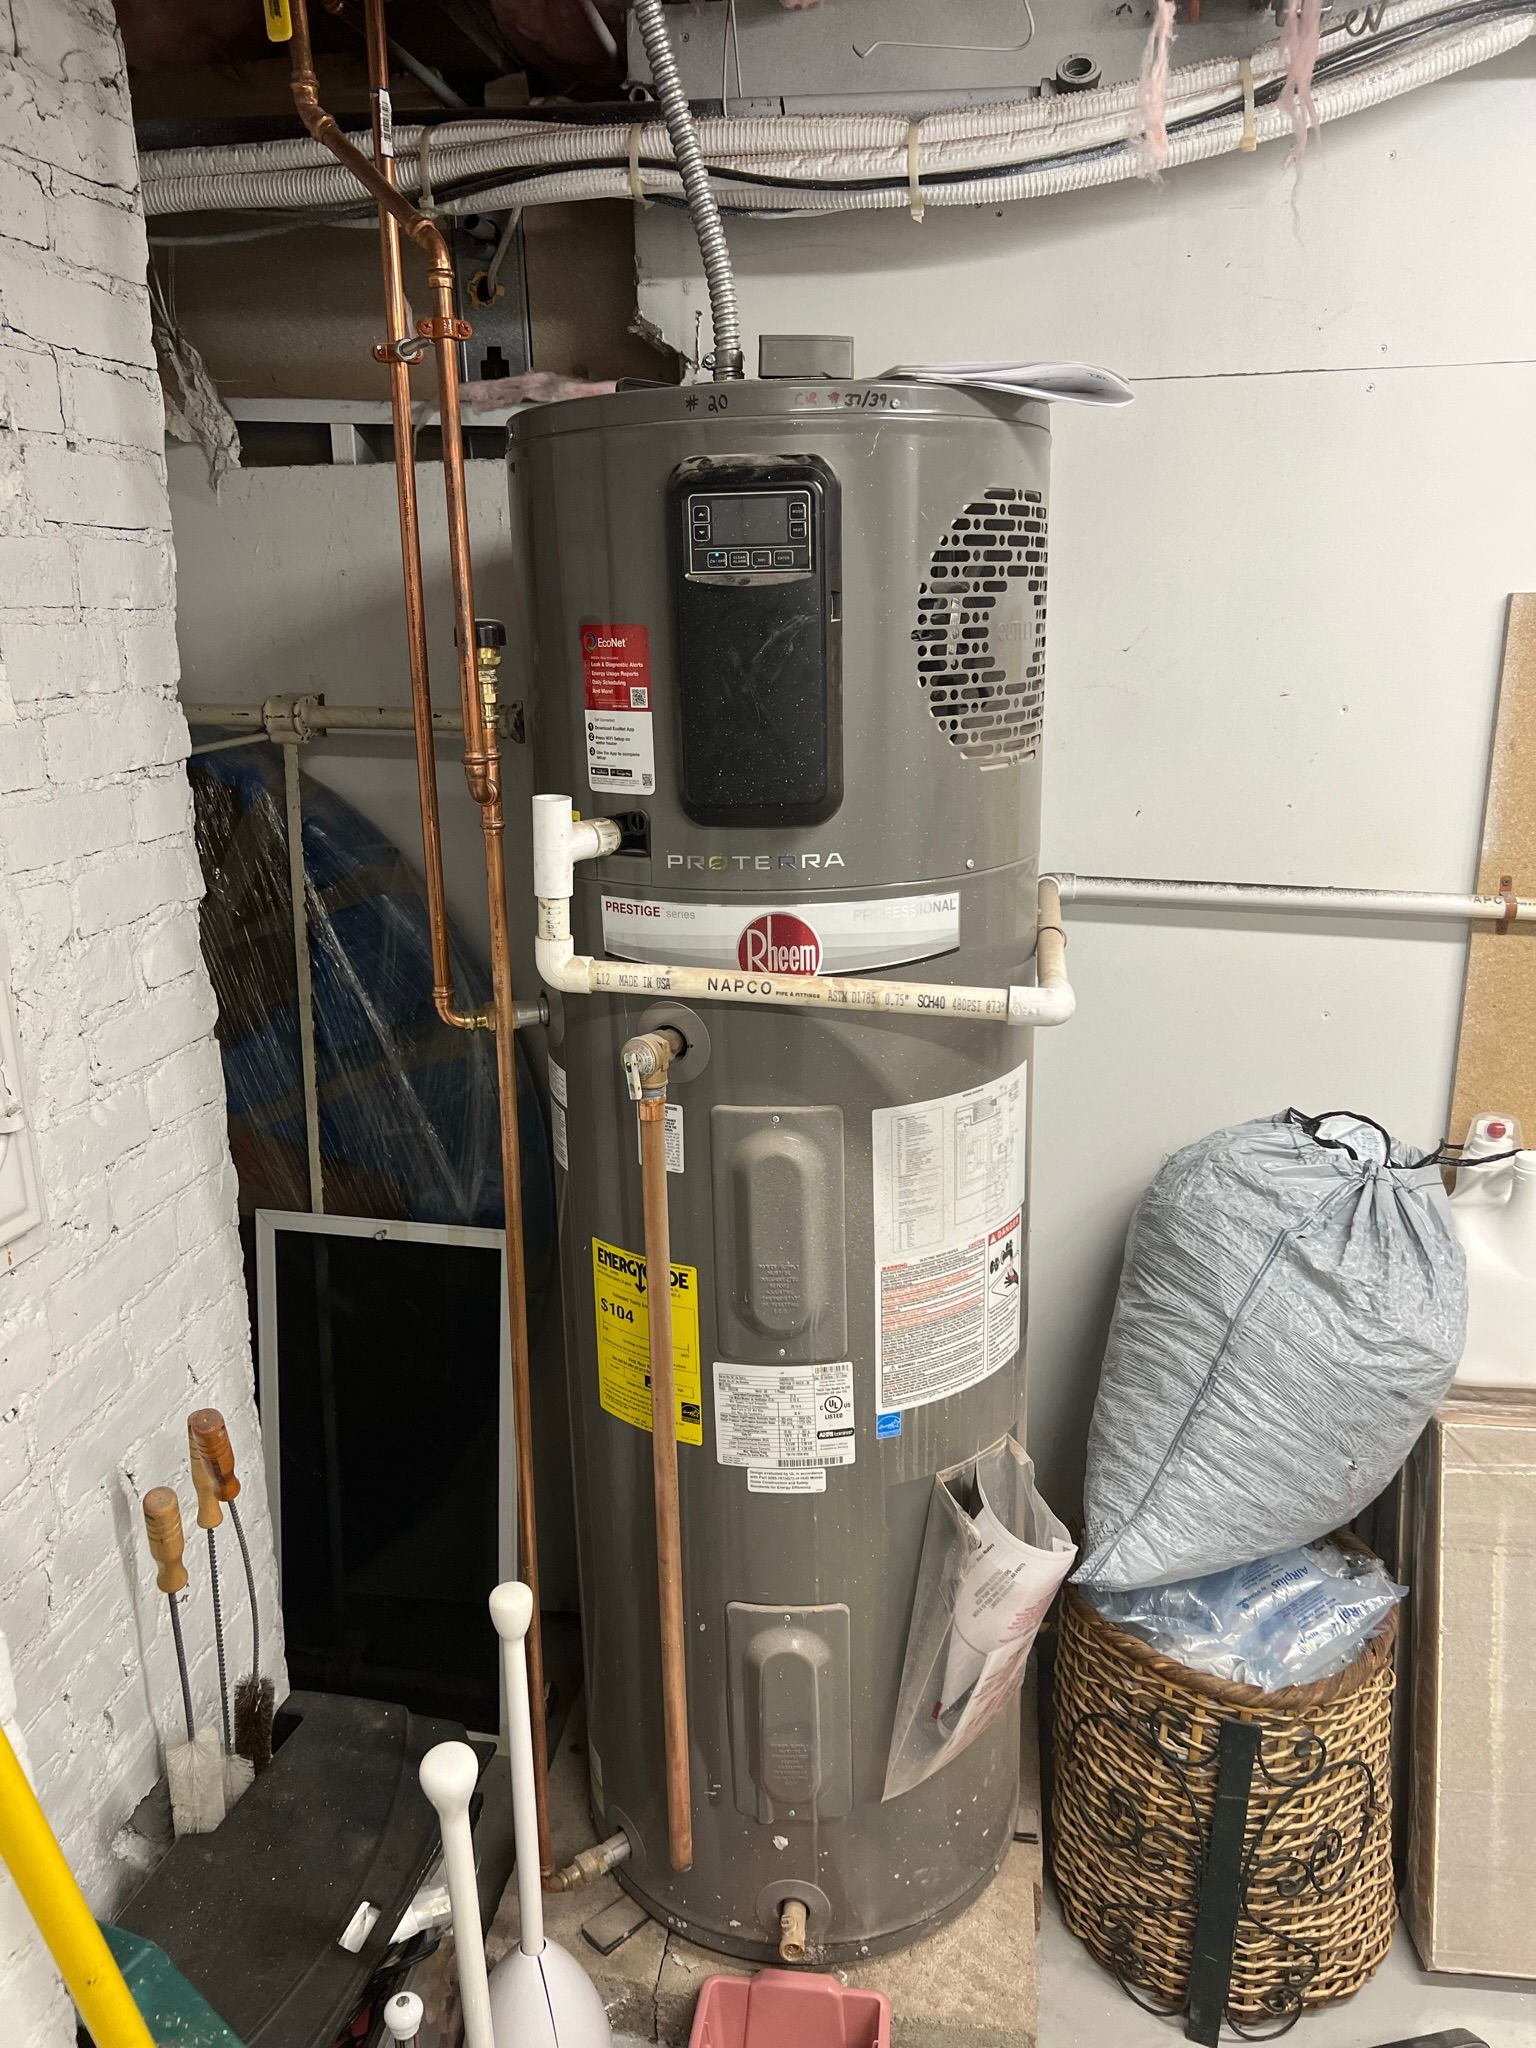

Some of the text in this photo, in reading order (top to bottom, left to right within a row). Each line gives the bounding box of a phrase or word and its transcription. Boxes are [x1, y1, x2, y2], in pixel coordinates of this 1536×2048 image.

[685, 394, 728, 413] # 20
[597, 637, 626, 648] EcoNet
[666, 851, 846, 871] PROTERRA
[605, 900, 696, 920] PRESTIGE series
[853, 897, 957, 921] PRFESSIONAL
[746, 915, 817, 973] Rheem
[618, 974, 638, 988] MADE
[642, 976, 653, 988] IN
[656, 976, 671, 990] USA
[707, 977, 772, 995] NAPCO
[827, 990, 848, 1004] ASTM
[851, 992, 876, 1005] D1785
[917, 993, 946, 1009] SCH40
[952, 997, 981, 1013] 480PSI
[996, 1215, 1021, 1241] DANGER
[600, 1297, 634, 1324] $104
[828, 1399, 839, 1409] UL
[824, 1412, 843, 1420] LISTED
[1270, 1565, 1308, 1588] AIRplus
